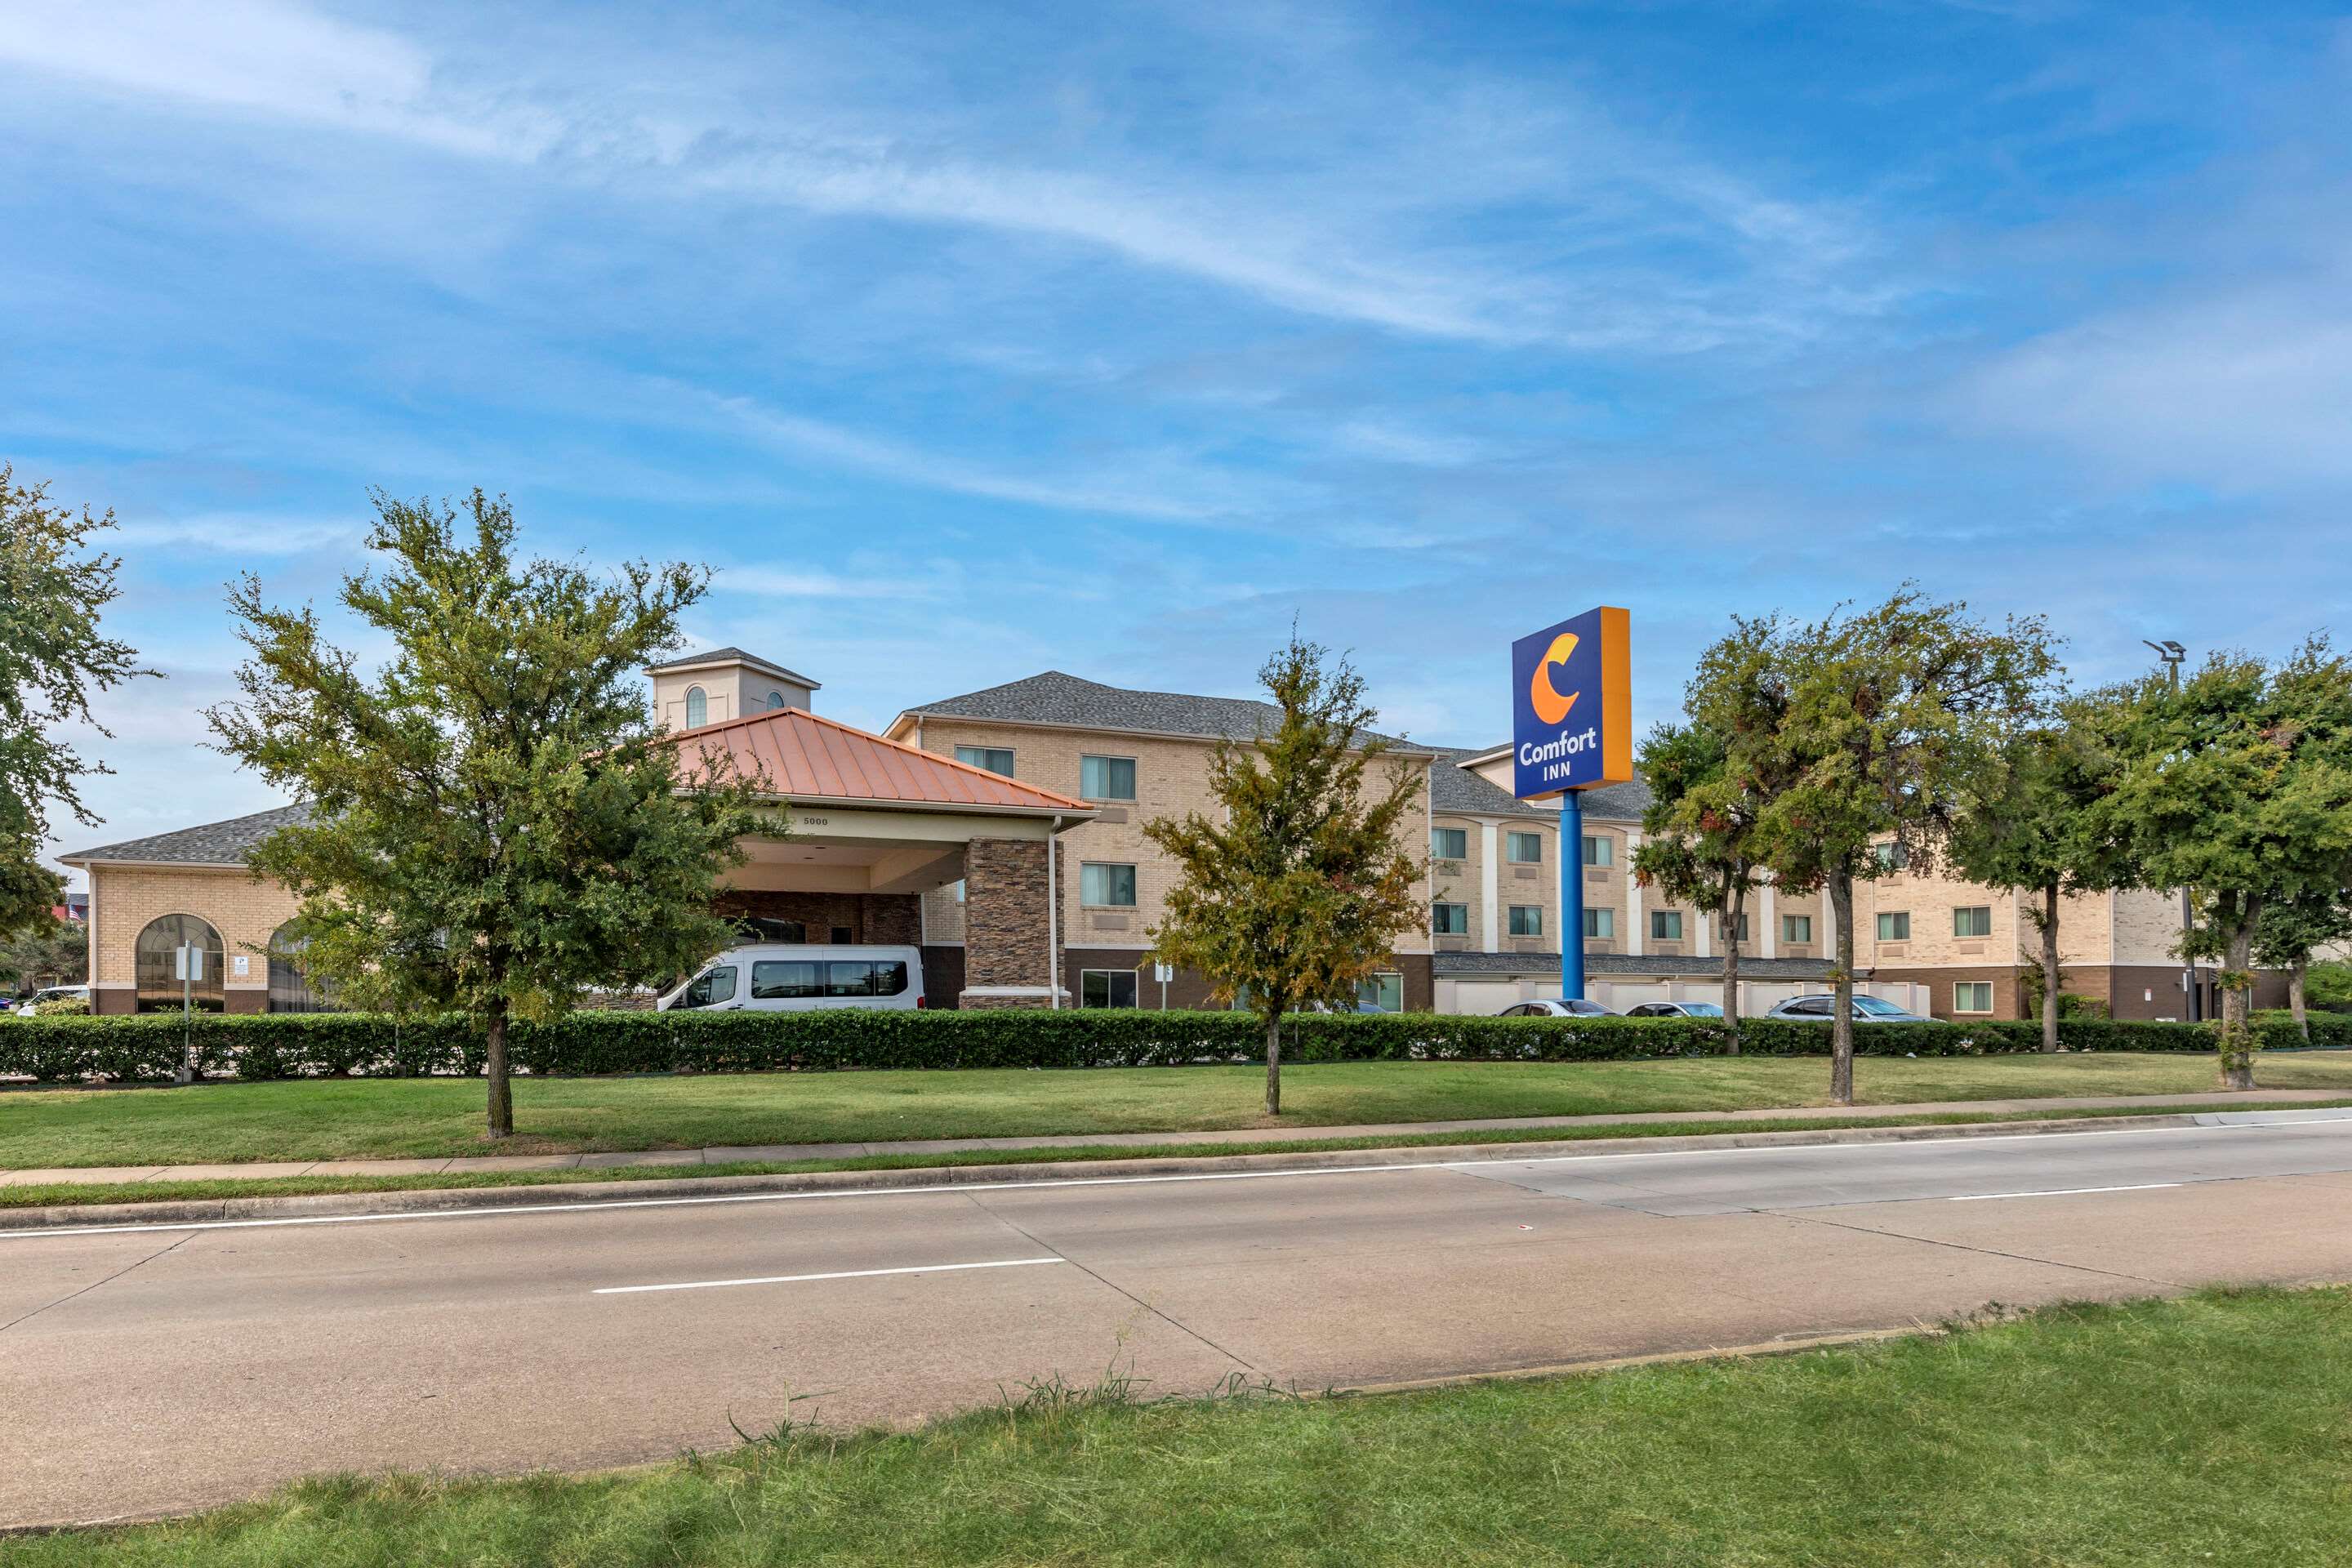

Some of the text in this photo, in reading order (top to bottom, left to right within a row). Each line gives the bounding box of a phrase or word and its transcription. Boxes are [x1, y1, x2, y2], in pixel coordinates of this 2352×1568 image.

[1520, 727, 1597, 766] Comfort
[1544, 760, 1570, 782] INN
[804, 817, 828, 826] 5000
